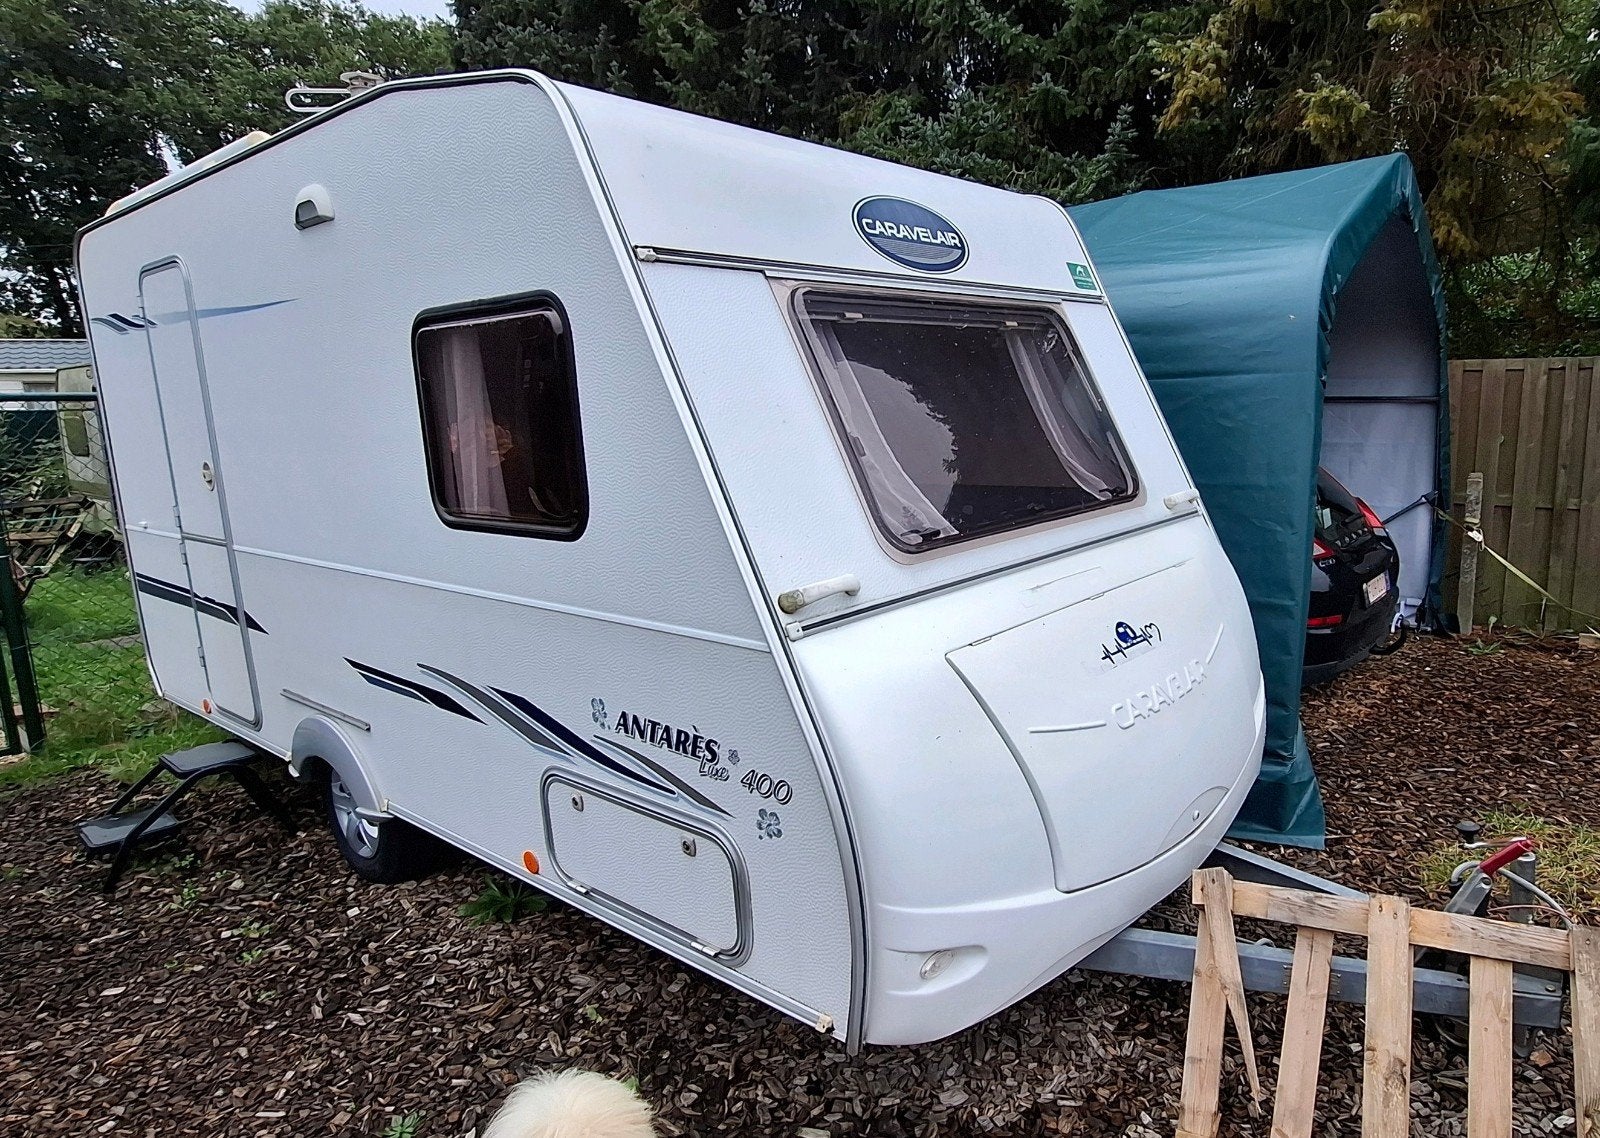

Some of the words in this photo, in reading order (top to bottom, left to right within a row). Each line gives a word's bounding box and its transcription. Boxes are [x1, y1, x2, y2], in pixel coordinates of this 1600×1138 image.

[861, 217, 962, 248] CARAVELAIR
[614, 711, 721, 765] ANTARÈS
[699, 754, 730, 782] Luxe
[741, 769, 793, 805] 400
